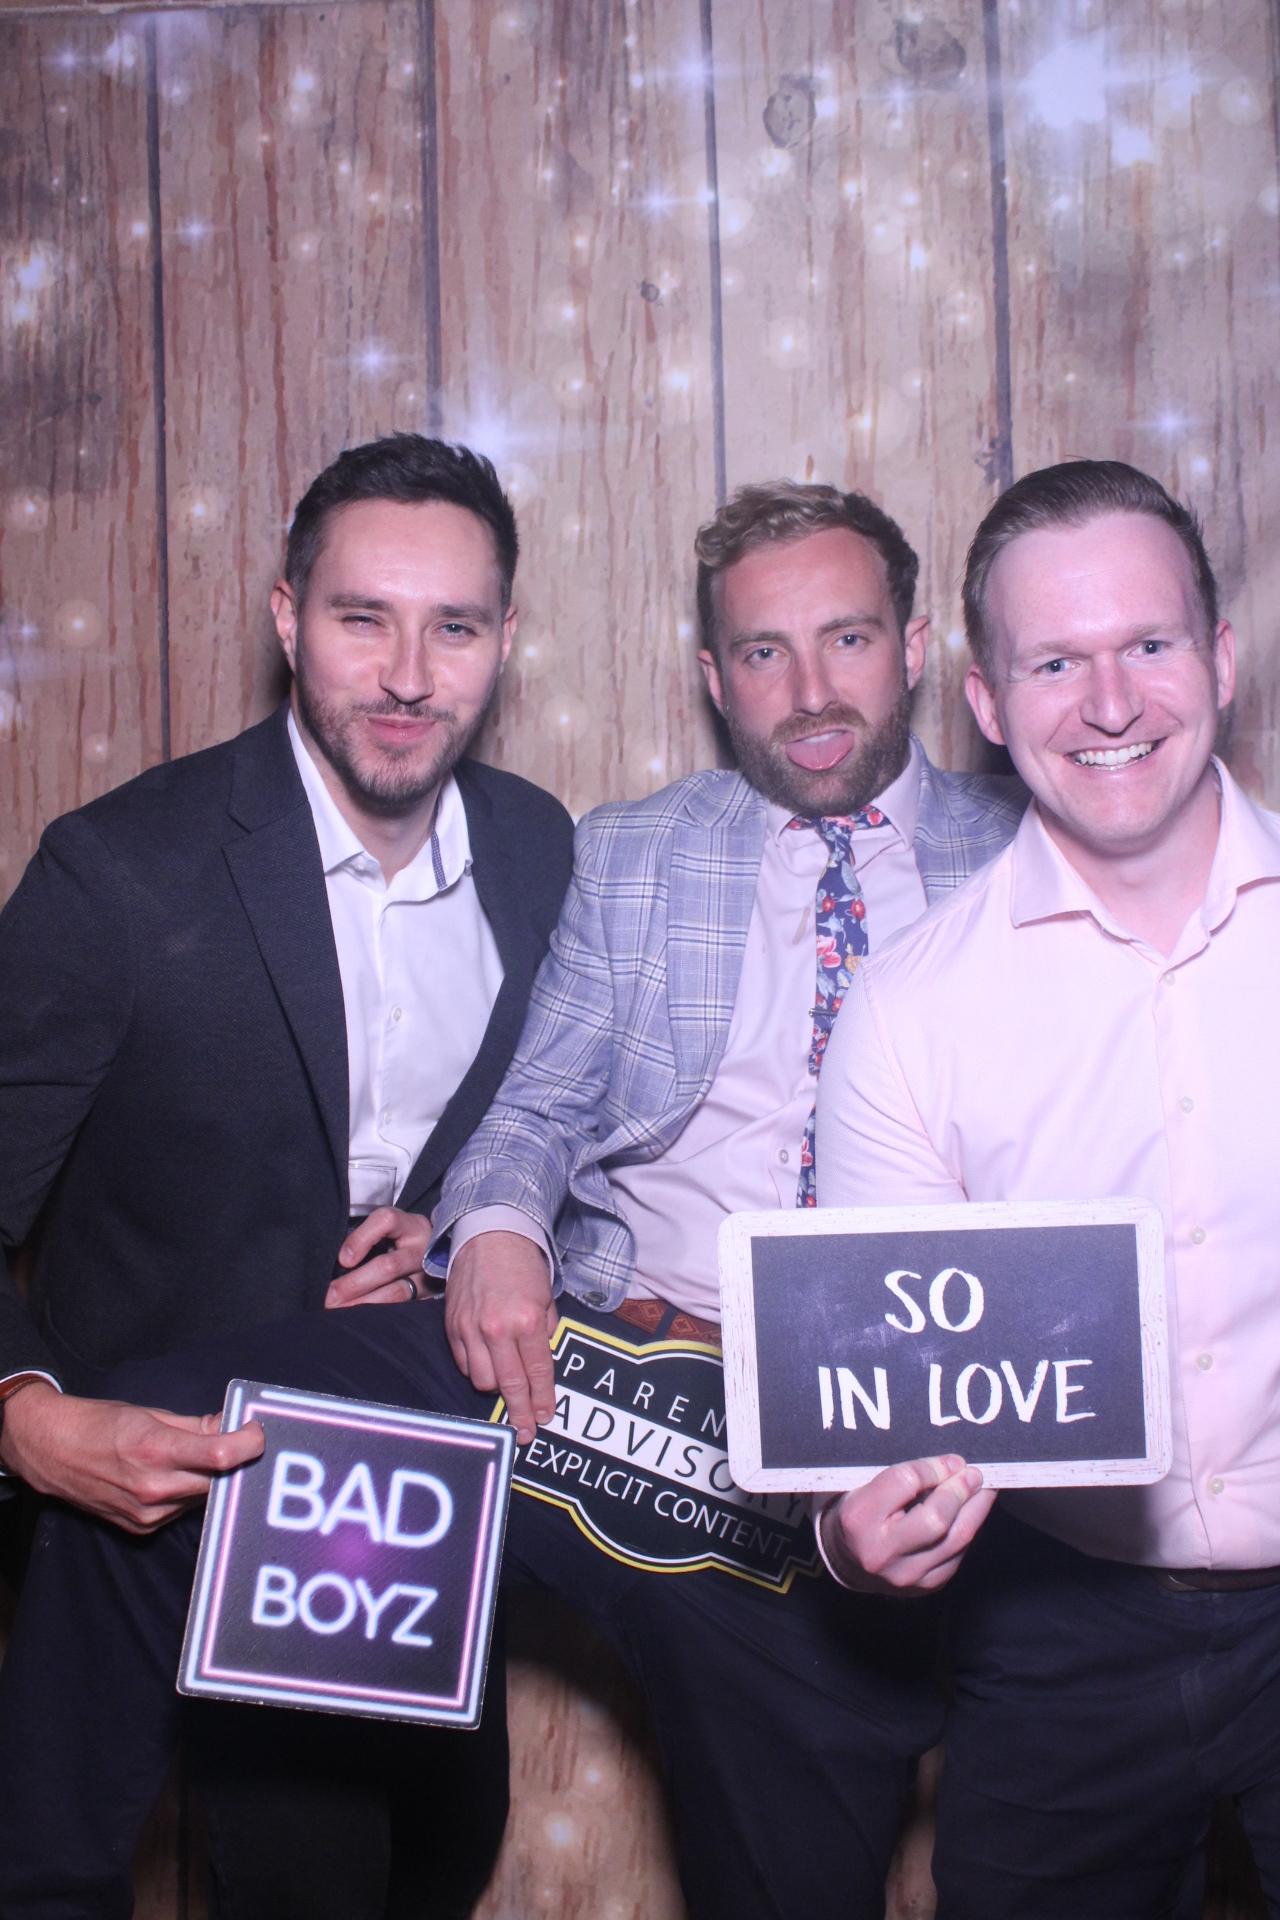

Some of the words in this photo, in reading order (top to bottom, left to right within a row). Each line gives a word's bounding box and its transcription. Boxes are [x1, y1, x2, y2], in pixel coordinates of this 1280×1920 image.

[884, 1267, 984, 1333] SO
[563, 1353, 727, 1438] PAREN
[818, 1365, 891, 1430] IN
[928, 1359, 1096, 1426] LOVE
[267, 1451, 453, 1548] BAD
[525, 1438, 653, 1505] EXPLICIT
[654, 1491, 792, 1559] CONTENT
[252, 1565, 438, 1647] BOYZ
